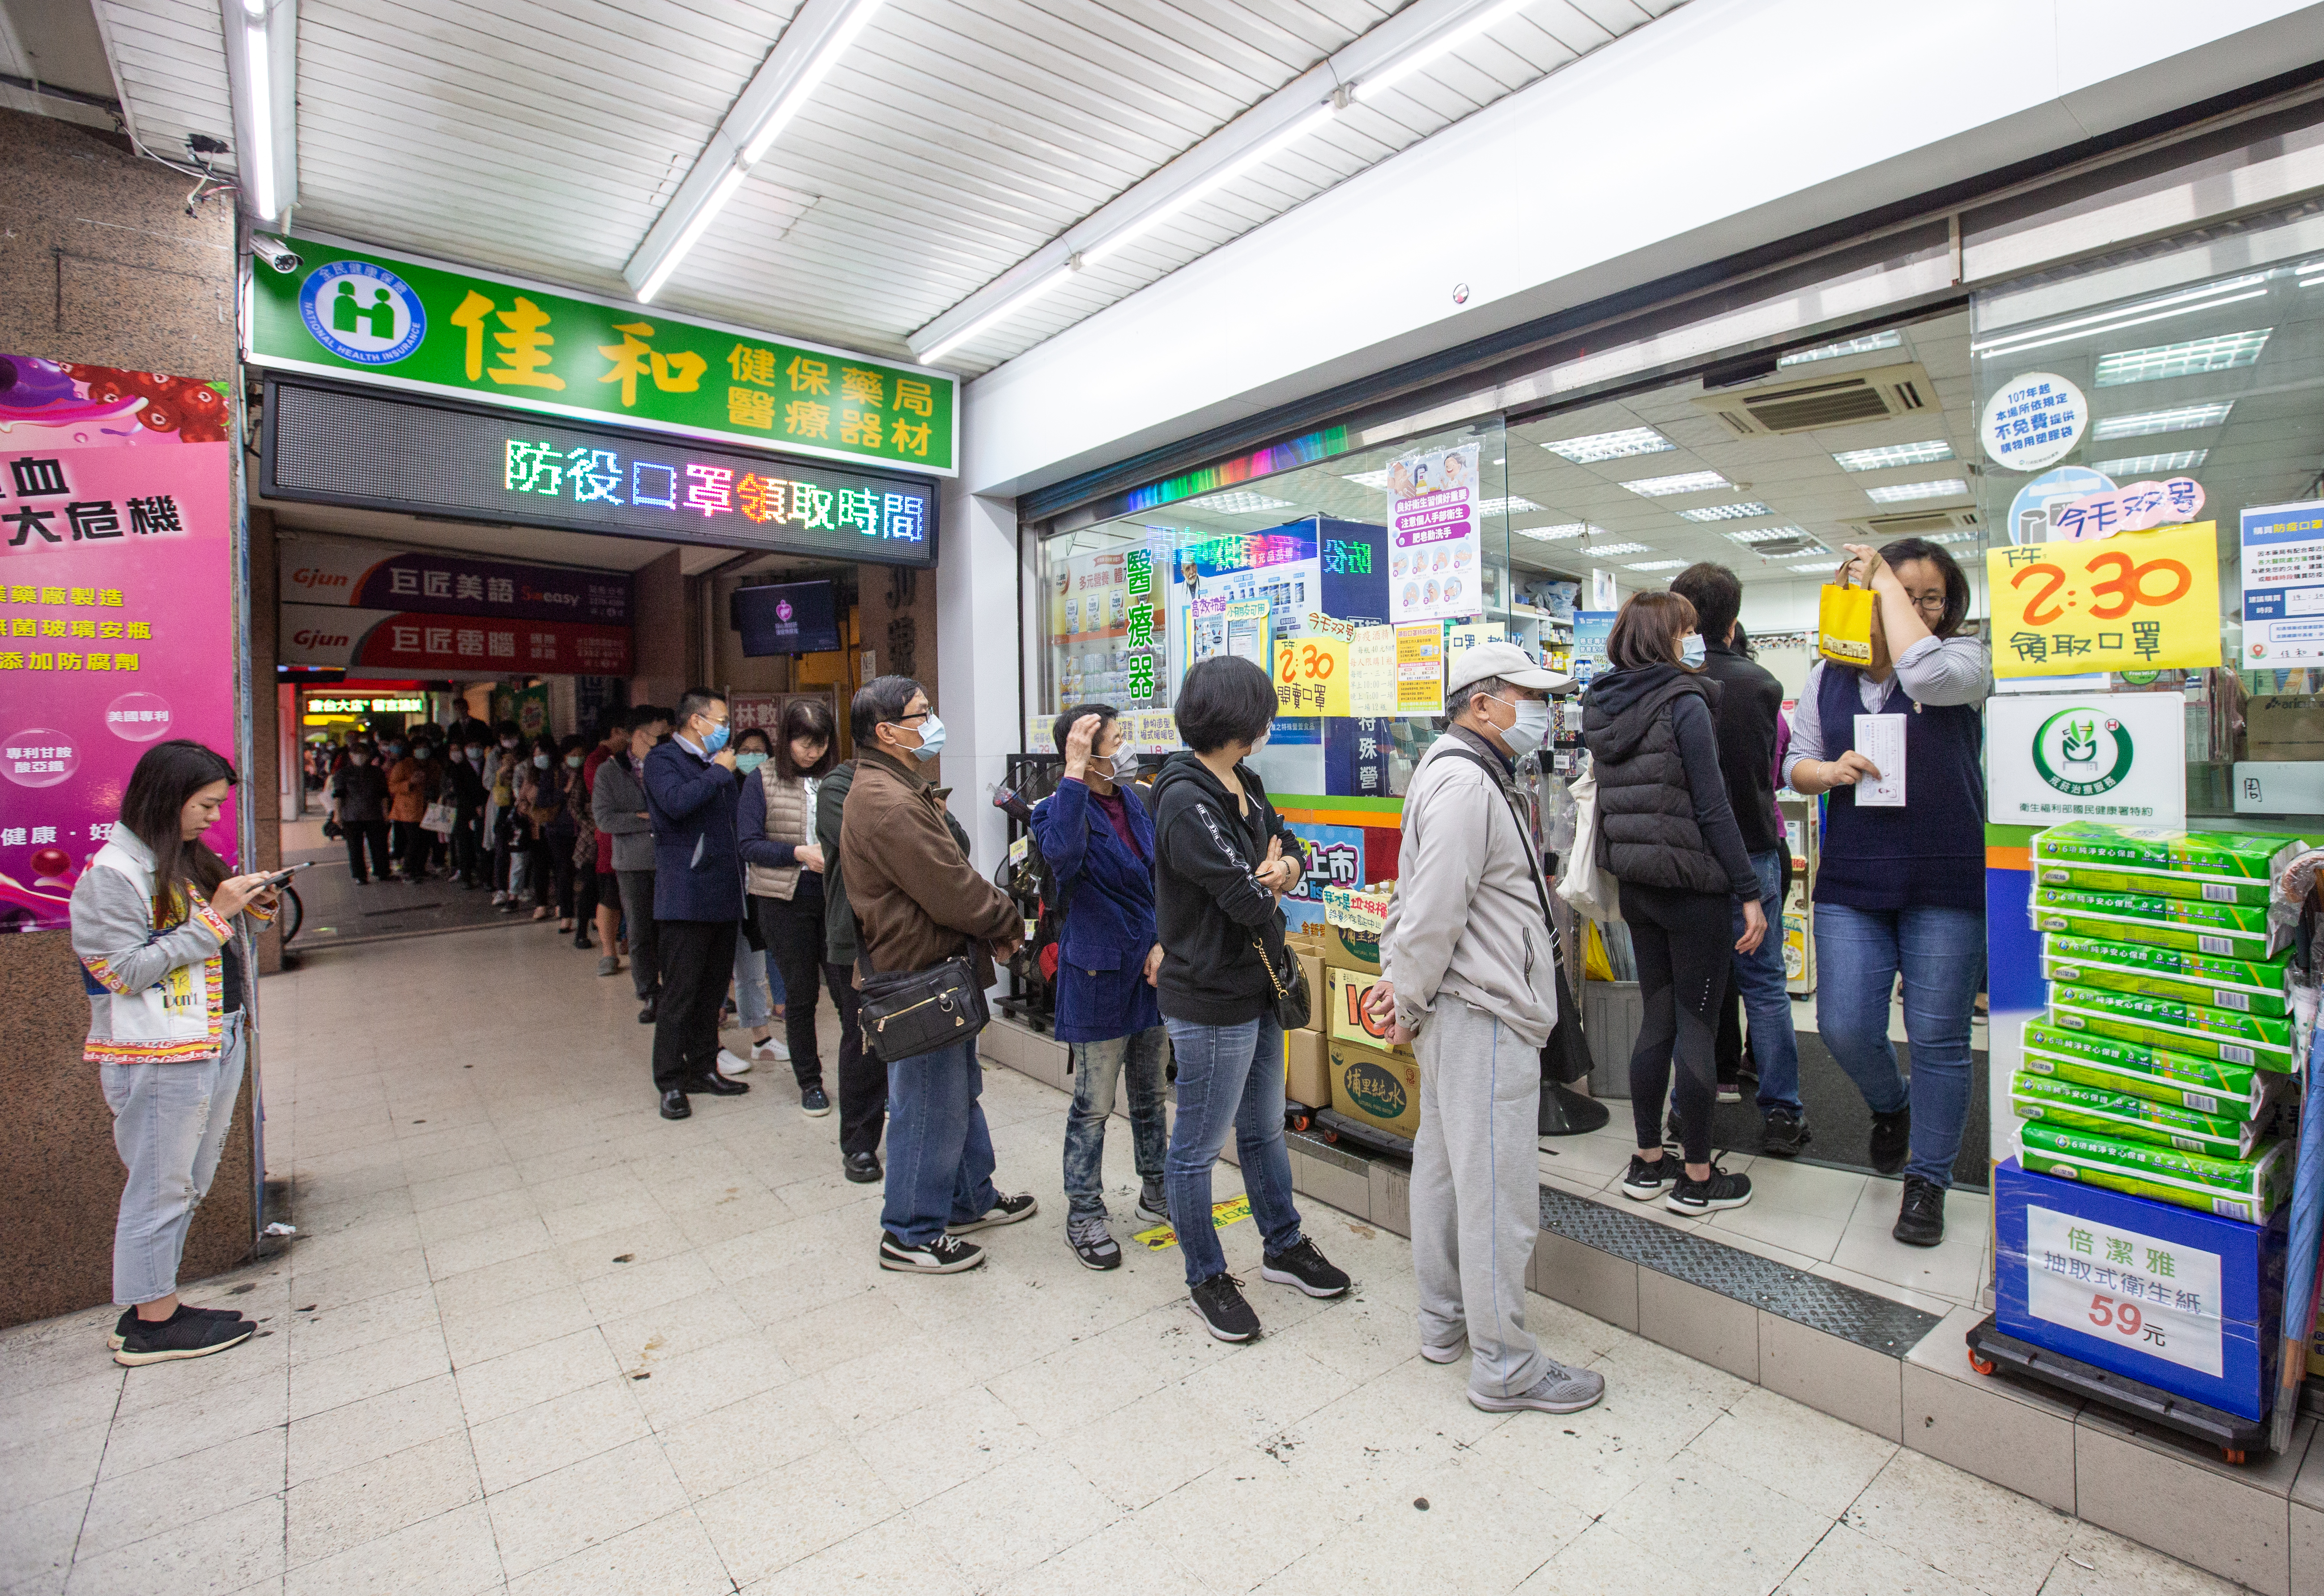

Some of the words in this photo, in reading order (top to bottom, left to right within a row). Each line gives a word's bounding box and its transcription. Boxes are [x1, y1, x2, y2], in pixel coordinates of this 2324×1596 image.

[304, 301, 335, 348] NATIONAL
[337, 345, 380, 361] HEALTH
[382, 322, 421, 360] INSURANCE
[451, 290, 707, 407] 佳和
[727, 344, 932, 417] 健保藥局
[2008, 383, 2051, 404] 107年起
[1996, 393, 2068, 421] 本場所依規定
[727, 386, 932, 456] 醫療器材
[1995, 410, 2075, 440] 不免費提供
[2001, 426, 2073, 454] 購物用塑膠袋
[0, 457, 70, 498] 血
[506, 439, 924, 541] 防役口罩領取時間
[1397, 488, 1467, 512] 良好衛生習慣好重要
[1, 495, 183, 546] 大危機
[1401, 508, 1464, 529] 注意個人手部衛生
[2253, 519, 2323, 535] 購買防疫口罩
[1413, 526, 1451, 544] 肥皂勤洗手
[2257, 545, 2324, 557] 因本藥局有配合鄰近
[2258, 555, 2324, 565] 各大醫院處方箋領藥
[293, 568, 349, 589] Gjun
[390, 567, 514, 603] 巨匠美語
[1079, 571, 1109, 590] 多元營養
[2258, 572, 2324, 582] 或離峰時段購買防疫
[0, 585, 123, 607] 藥廠製造
[2011, 551, 2192, 626] 2:30
[1192, 596, 1226, 617] 高效抗菌
[1227, 603, 1265, 618] 小朋友可用
[293, 629, 349, 649] Gjun
[1127, 549, 1153, 711] 醫療器
[1354, 629, 1389, 642] 防疫酒精
[392, 626, 515, 658] 巨匠電腦
[2009, 621, 2161, 663] 領取口罩
[0, 652, 139, 671] 添加防腐劑
[1280, 645, 1334, 683] 2:30
[1278, 683, 1326, 712] 開賣口罩
[108, 710, 169, 722] 美國專利
[1143, 718, 1170, 729] 動物造型
[1141, 730, 1175, 740] 握式暖暖包
[6, 747, 72, 759] 專利甘胺
[1358, 717, 1378, 797] 特殊營
[14, 761, 64, 773] 酸亞鐵
[2049, 775, 2117, 795] 戒菸治療服務
[2019, 803, 2153, 817] 衛生福利部國民健康署特約
[1209, 824, 1219, 840] NIKE
[2062, 845, 2136, 859] 6項純淨安心保證
[1307, 847, 1354, 882] 上市
[2060, 893, 2133, 909] 6項純淨安心保證
[2073, 943, 2148, 961] 6項純淨安心保證
[2079, 993, 2153, 1013] 6項純淨安心保證
[2048, 1036, 2120, 1059] 6項純淨安心保證
[1347, 1069, 1405, 1108] 埔里純水
[2037, 1083, 2108, 1105] 6項純淨安心保證
[2071, 1141, 2146, 1163] 6項純淨安心保證
[2067, 1227, 2176, 1278] 倍潔雅
[2044, 1251, 2201, 1315] 抽取式衛生紙
[2088, 1294, 2142, 1336] 59
[2143, 1323, 2166, 1348] 元
